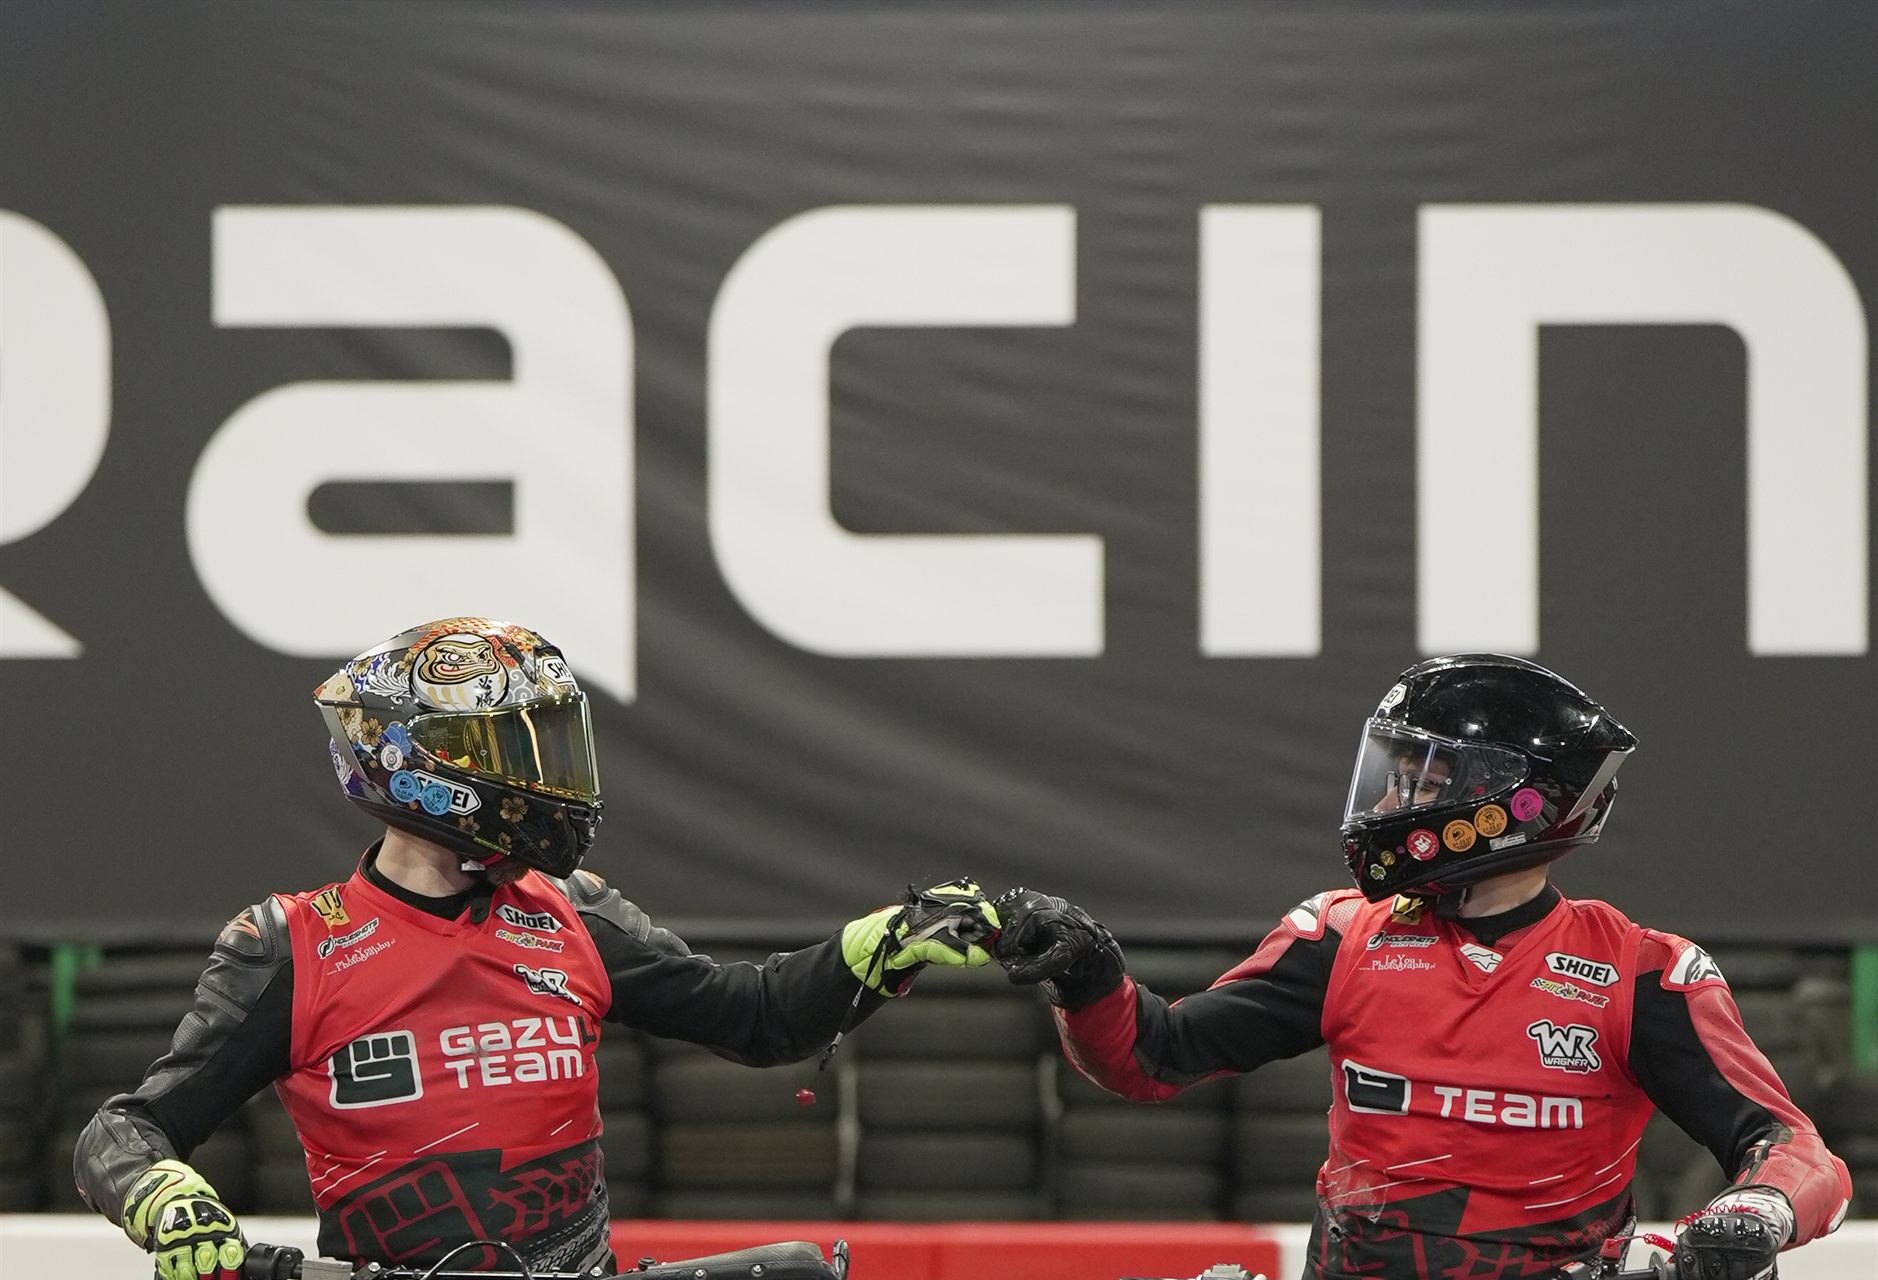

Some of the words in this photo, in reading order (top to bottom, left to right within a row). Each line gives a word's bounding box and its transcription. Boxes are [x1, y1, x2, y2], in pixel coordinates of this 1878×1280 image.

[0, 204, 1868, 702] acin
[504, 907, 556, 930] SHOEI
[1553, 956, 1611, 984] SHOEI
[1543, 1056, 1589, 1067] WAGNER
